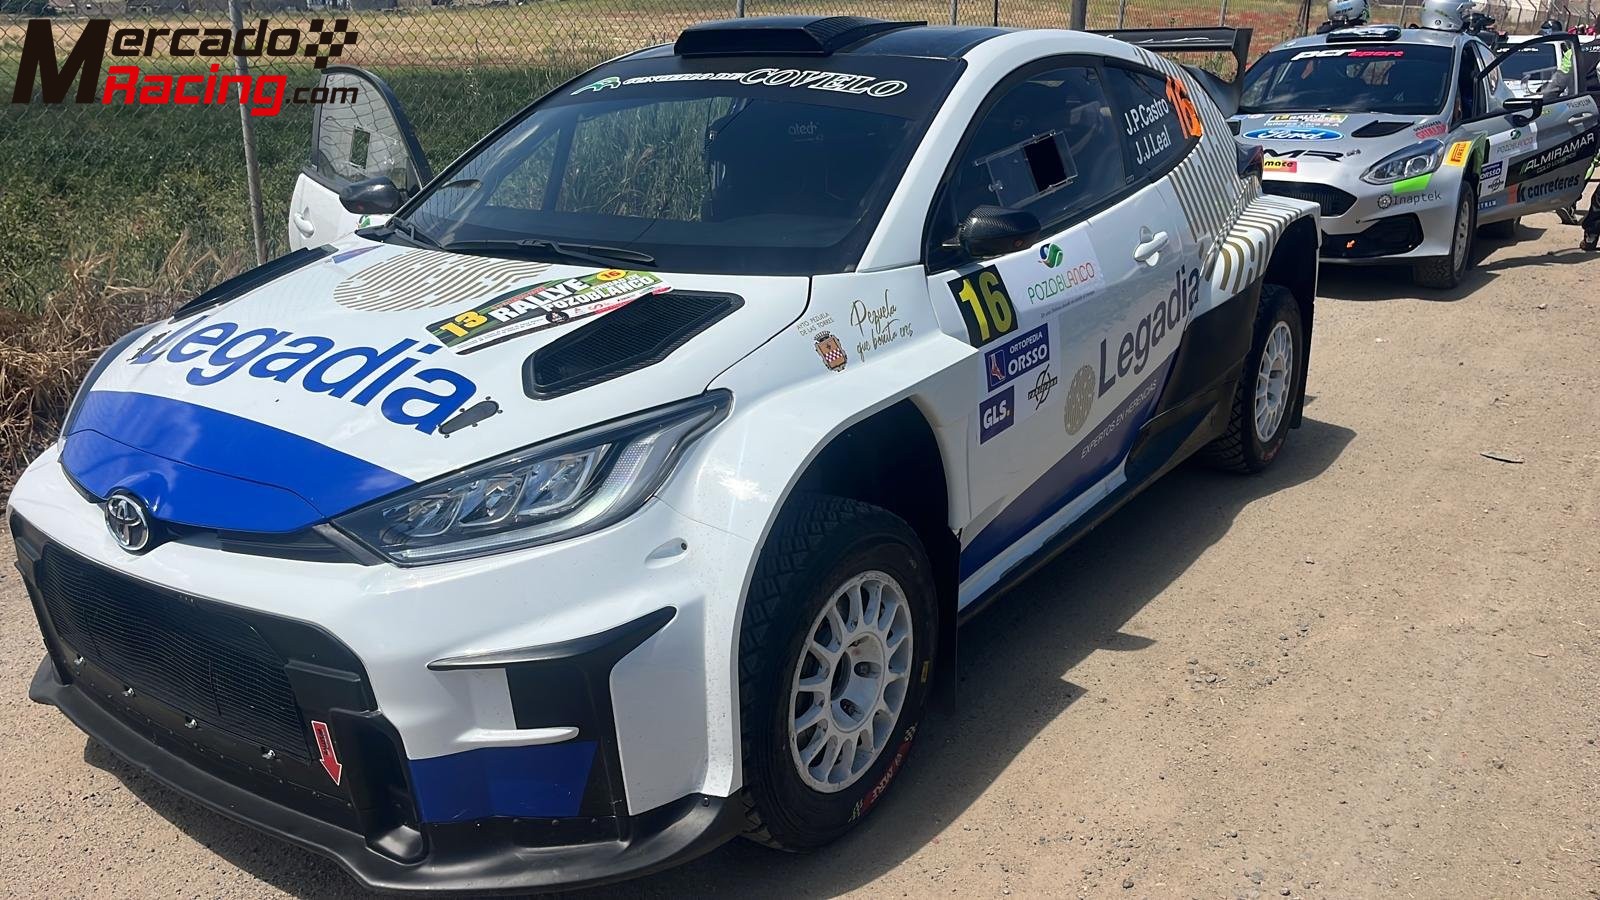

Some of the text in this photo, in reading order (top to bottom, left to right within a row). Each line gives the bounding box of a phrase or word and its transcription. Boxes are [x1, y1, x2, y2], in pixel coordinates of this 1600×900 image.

[740, 69, 907, 97] COVELO
[1124, 98, 1169, 136] J.P.Castro
[1257, 128, 1326, 139] Ford
[1135, 124, 1171, 165] J.J.Leal
[1524, 132, 1595, 173] ALMIRAMAR
[1393, 190, 1442, 205] Inaptek
[488, 278, 591, 323] RALLYE
[542, 276, 655, 312] POZOBLANCO
[1028, 262, 1095, 304] POZOBLANCO
[440, 311, 488, 337] 13
[958, 271, 1012, 342] 16
[1009, 331, 1043, 354] ORTOPEDIA
[1098, 264, 1200, 399] Legadia
[129, 314, 478, 436] Legadia
[1008, 343, 1048, 375] ORSSO
